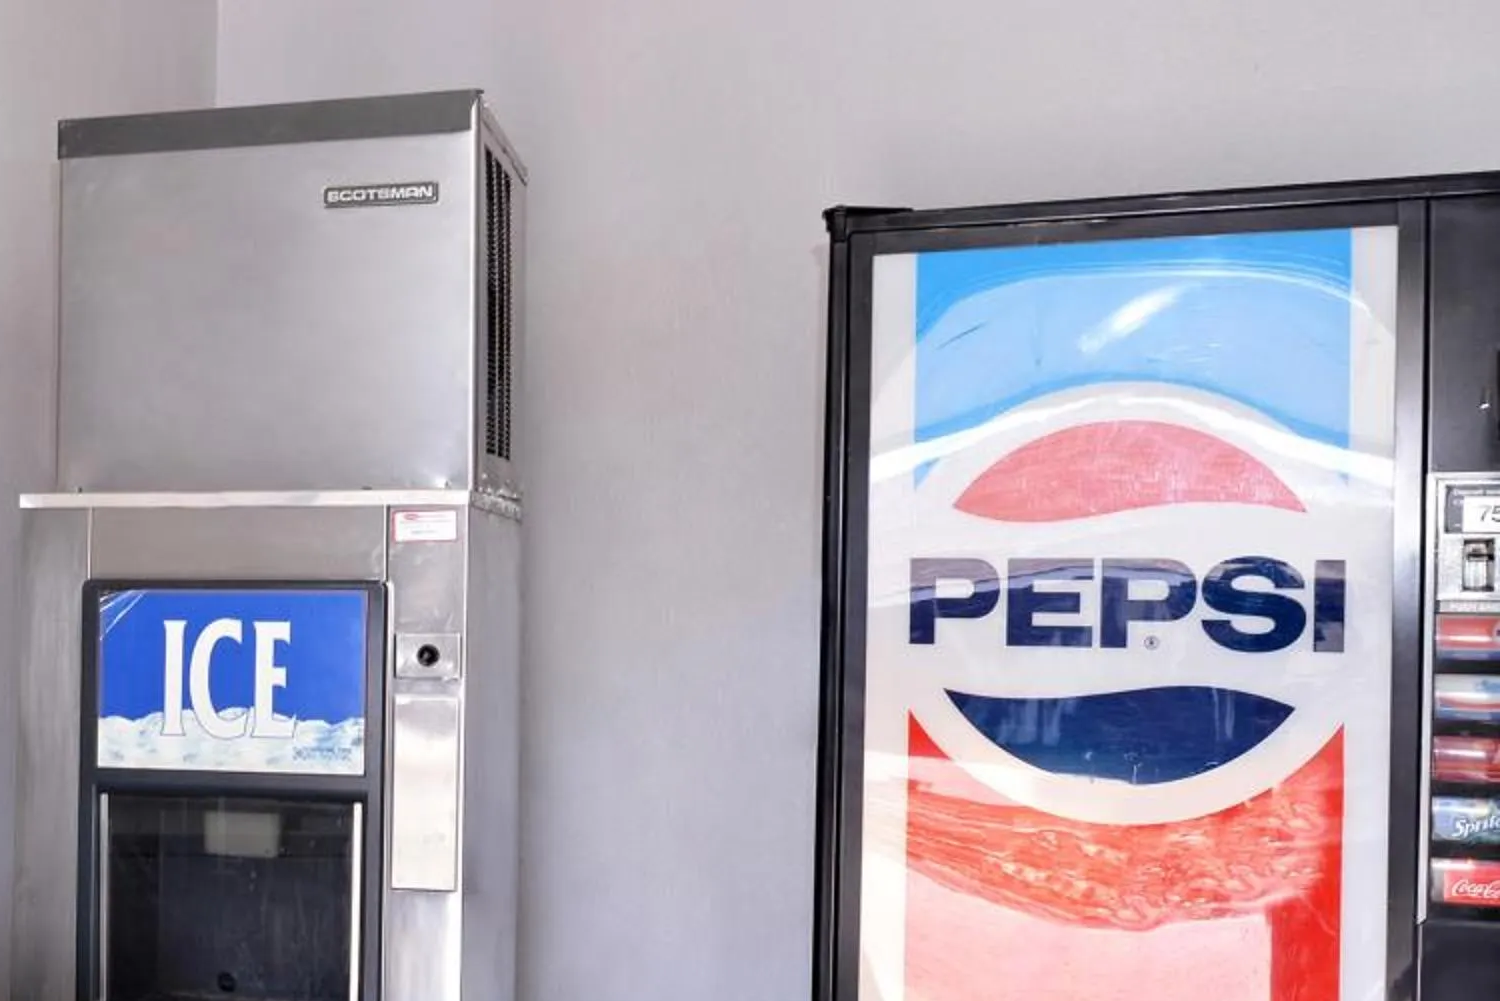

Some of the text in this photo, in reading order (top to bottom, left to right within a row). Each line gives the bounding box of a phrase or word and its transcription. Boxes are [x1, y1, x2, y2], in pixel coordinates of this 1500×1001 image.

[327, 185, 433, 203] SCOTSMAN
[909, 556, 1346, 653] PEPSI
[160, 617, 296, 740] ICE
